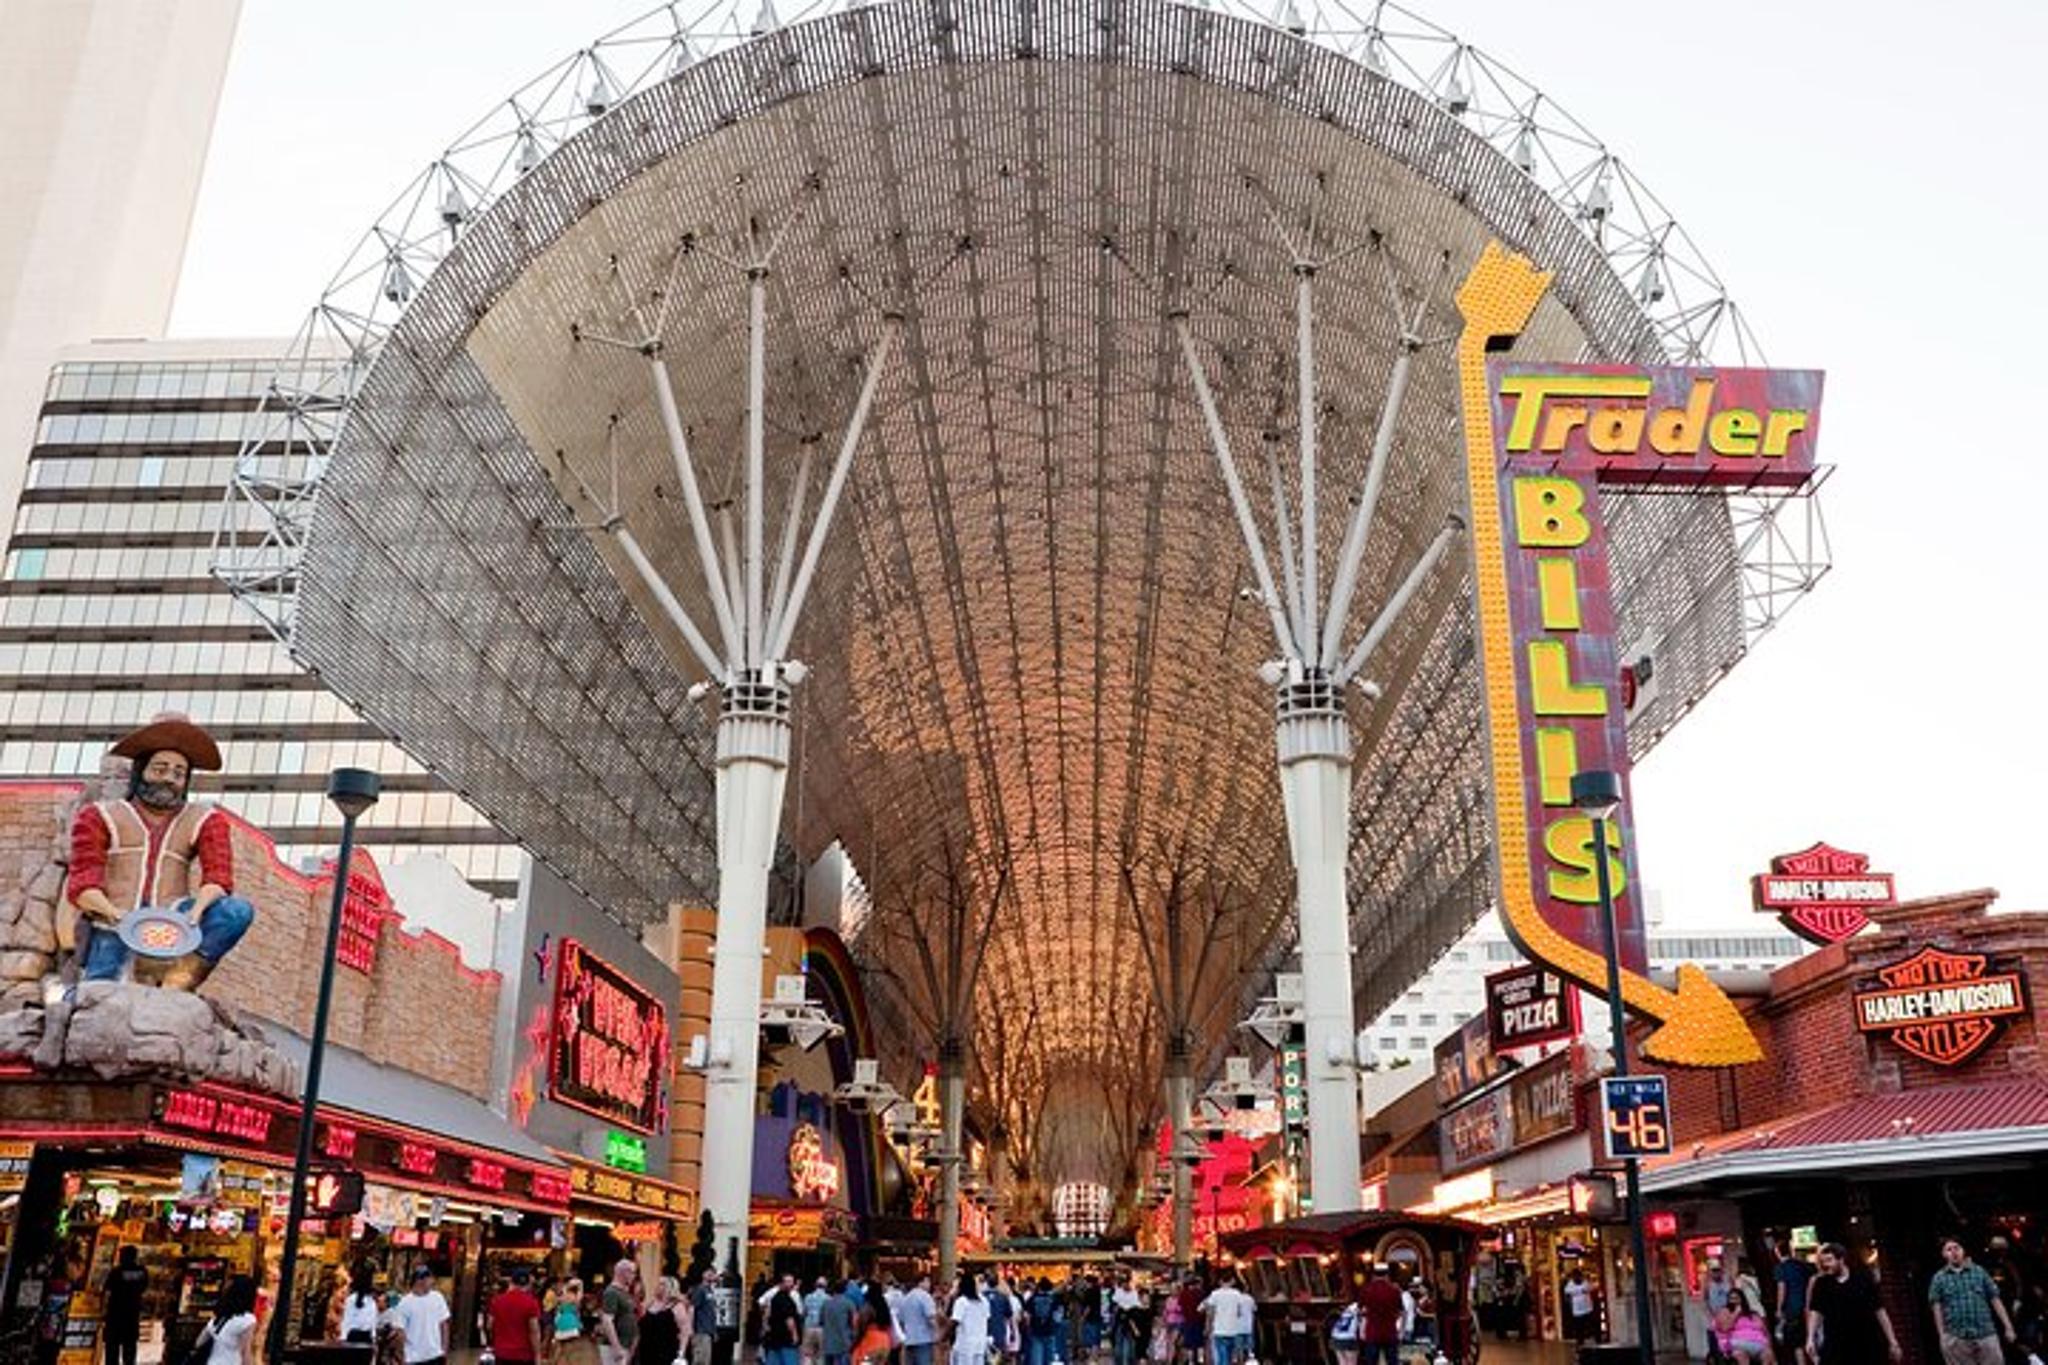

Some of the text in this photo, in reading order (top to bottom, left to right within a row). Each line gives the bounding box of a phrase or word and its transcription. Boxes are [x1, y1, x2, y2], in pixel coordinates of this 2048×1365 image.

[1499, 375, 1807, 457] Trader
[1793, 857, 1857, 874] MOTOR
[1768, 880, 1890, 900] HARLEY-DAVIDSON
[1802, 906, 1863, 936] CYCLES
[1893, 953, 1972, 987] MOTOR
[1502, 997, 1559, 1036] PIZZA
[1863, 981, 2015, 1023] HARLEY-DAVIDSON
[1904, 1019, 1983, 1057] CYCLES
[1609, 1105, 1665, 1150] 46
